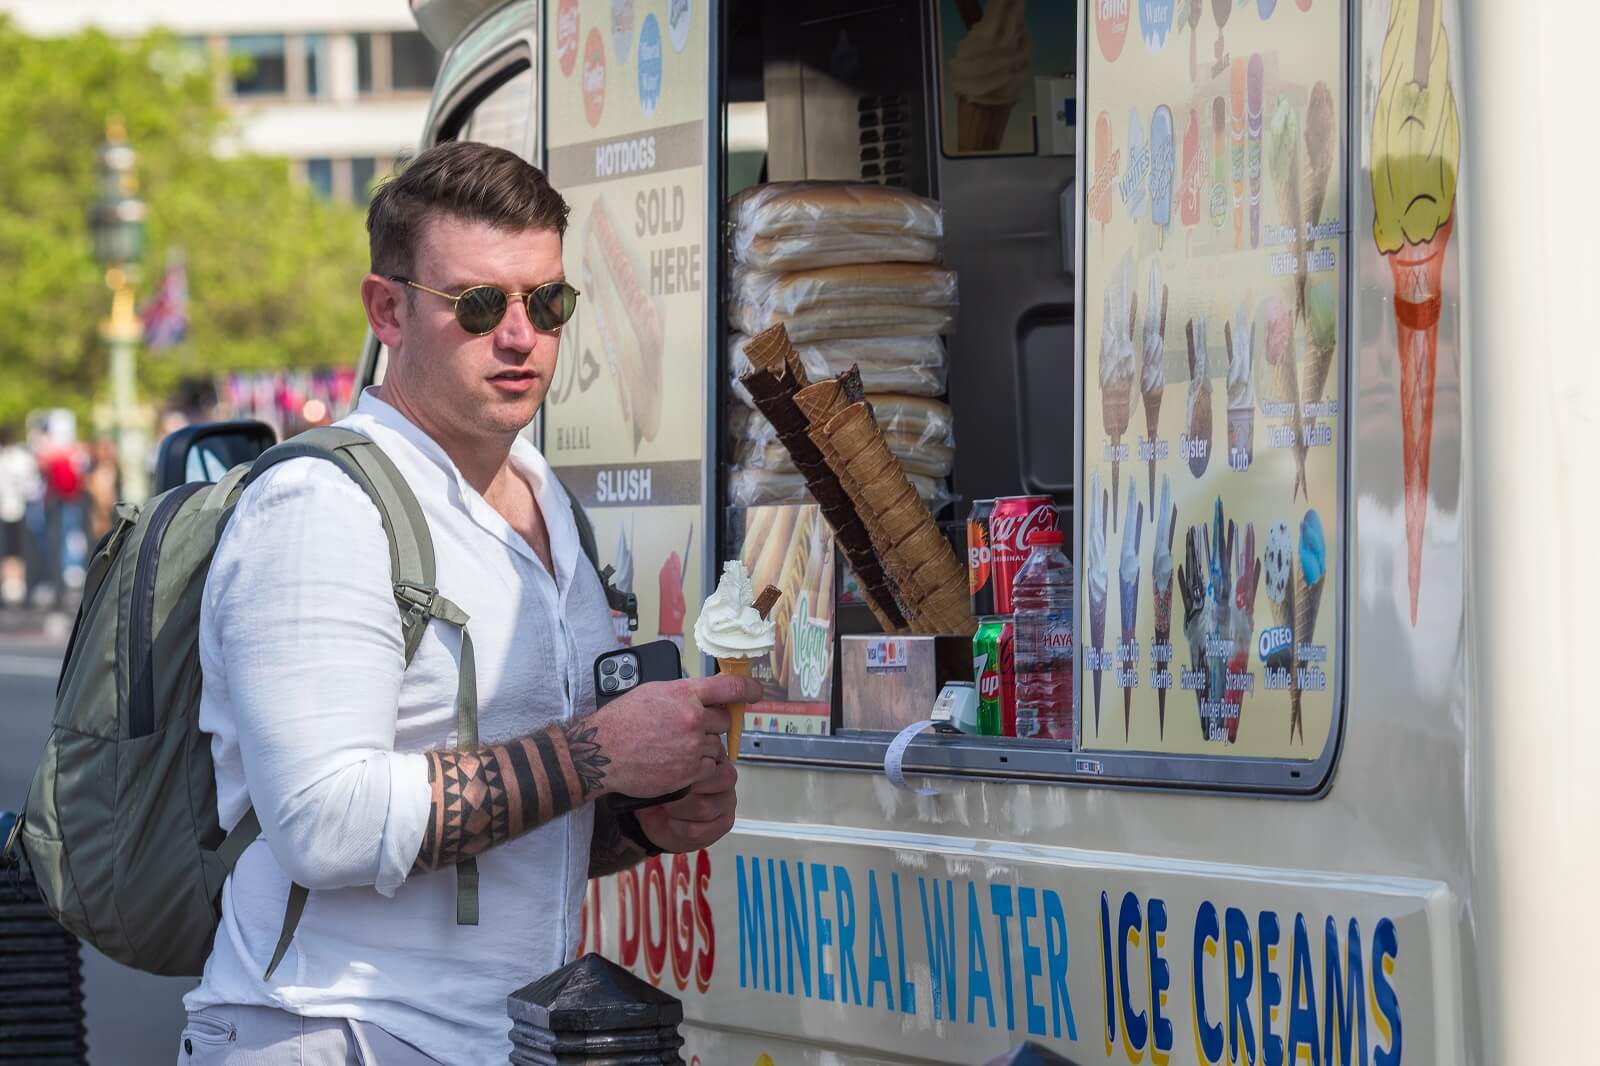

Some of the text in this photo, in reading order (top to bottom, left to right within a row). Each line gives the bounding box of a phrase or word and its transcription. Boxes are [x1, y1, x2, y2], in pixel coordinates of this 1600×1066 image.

[595, 136, 656, 177] HOTDOGS
[1118, 149, 1151, 206] WHITES
[635, 185, 685, 238] SOLD
[650, 244, 701, 297] HERE
[1271, 250, 1298, 274] Waffle
[1306, 247, 1336, 273] Waffle
[556, 426, 591, 450] HALAL
[1265, 424, 1296, 448] Waffle
[1303, 423, 1332, 447] Waffle
[1179, 433, 1208, 463] Oyster
[1231, 447, 1249, 471] Tub
[596, 468, 651, 502] SLUSH
[1205, 633, 1235, 662] Bubblegum
[1259, 627, 1293, 657] OREO
[1296, 642, 1326, 662] Bubblegum
[1116, 668, 1139, 689] Waffle
[1151, 668, 1173, 689] Waffle
[1179, 665, 1206, 690] Chocolate
[1225, 668, 1255, 697] Strawberry
[1263, 667, 1292, 690] Waffle
[1296, 667, 1326, 690] Waffle
[1200, 698, 1240, 718] Knicker Bocker
[1208, 721, 1229, 745] Glory
[618, 848, 716, 993] DOGS
[736, 855, 916, 1015] MINERAL
[918, 876, 1079, 1041] WATER
[1099, 889, 1403, 1066] ICE CREAMS
